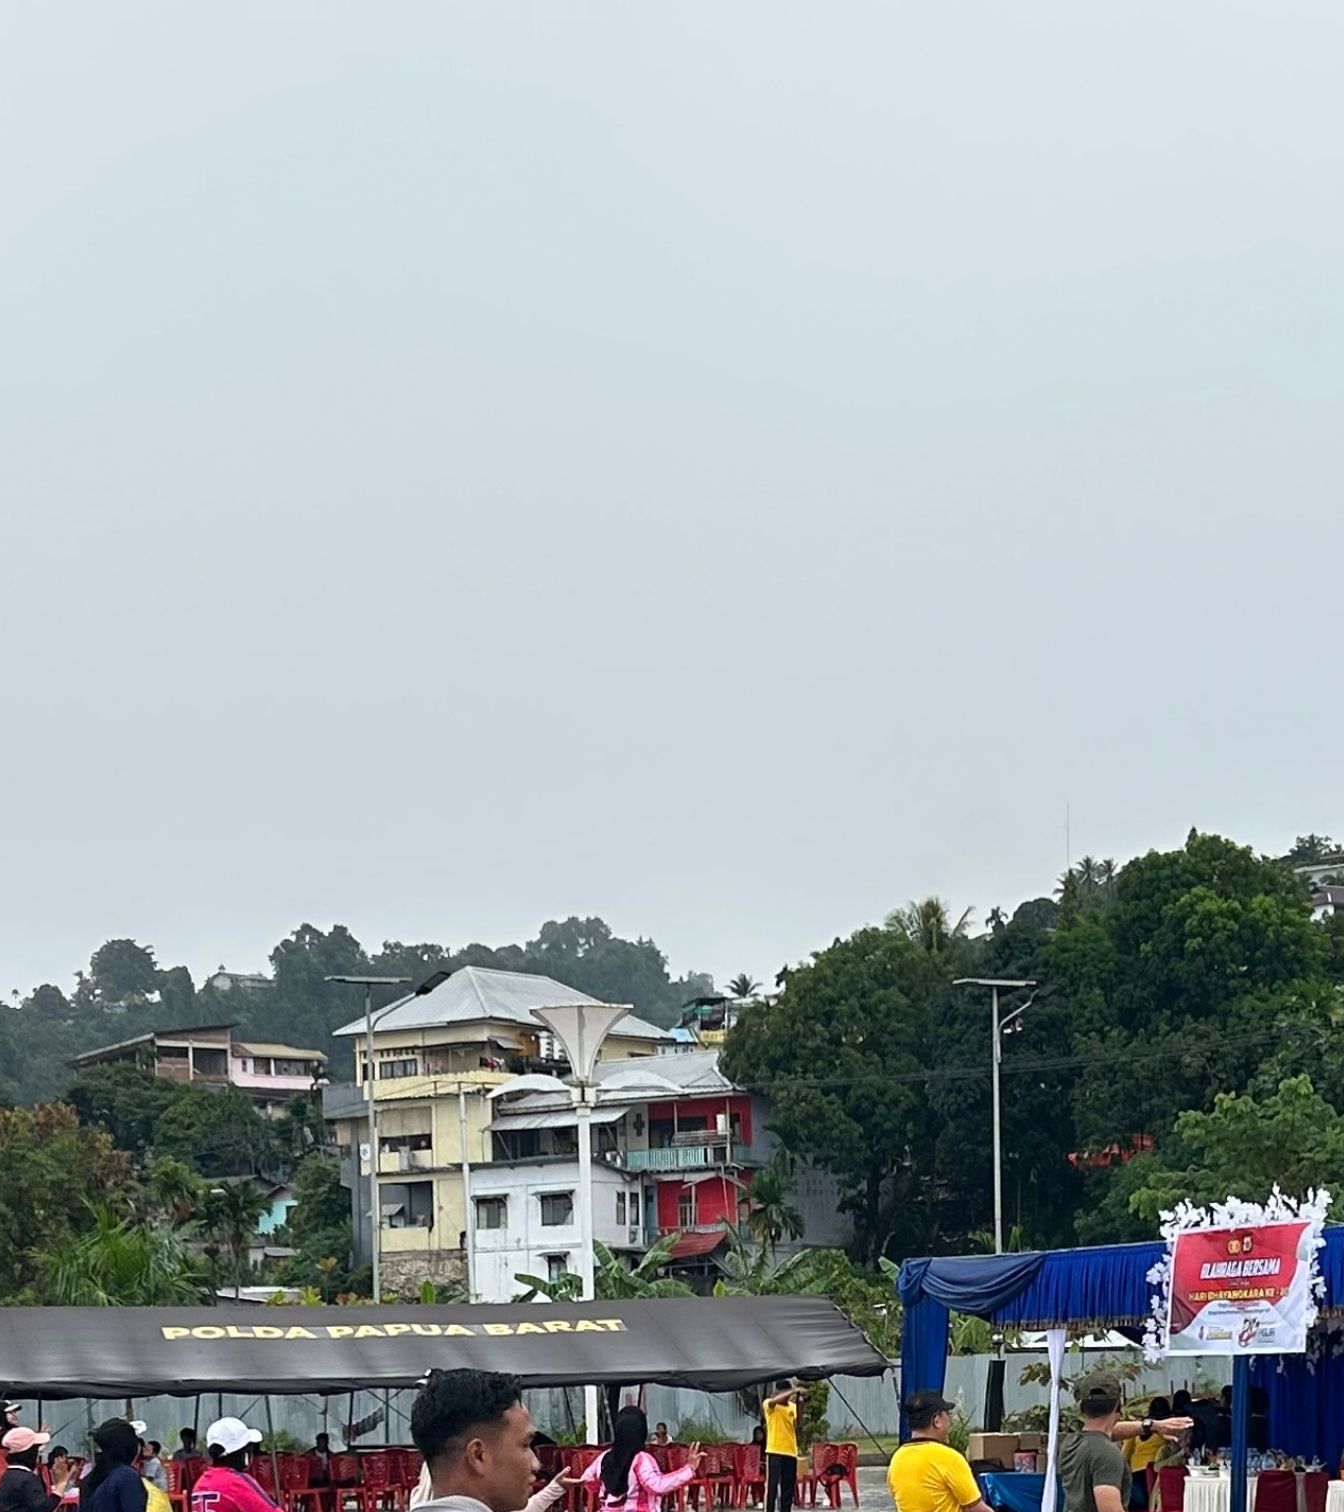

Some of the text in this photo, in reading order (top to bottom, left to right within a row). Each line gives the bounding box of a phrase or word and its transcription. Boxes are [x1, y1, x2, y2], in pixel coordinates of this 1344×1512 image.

[1243, 1258, 1282, 1277] BERSAMA
[161, 1319, 623, 1341] POLDA PAPUA BARAT
